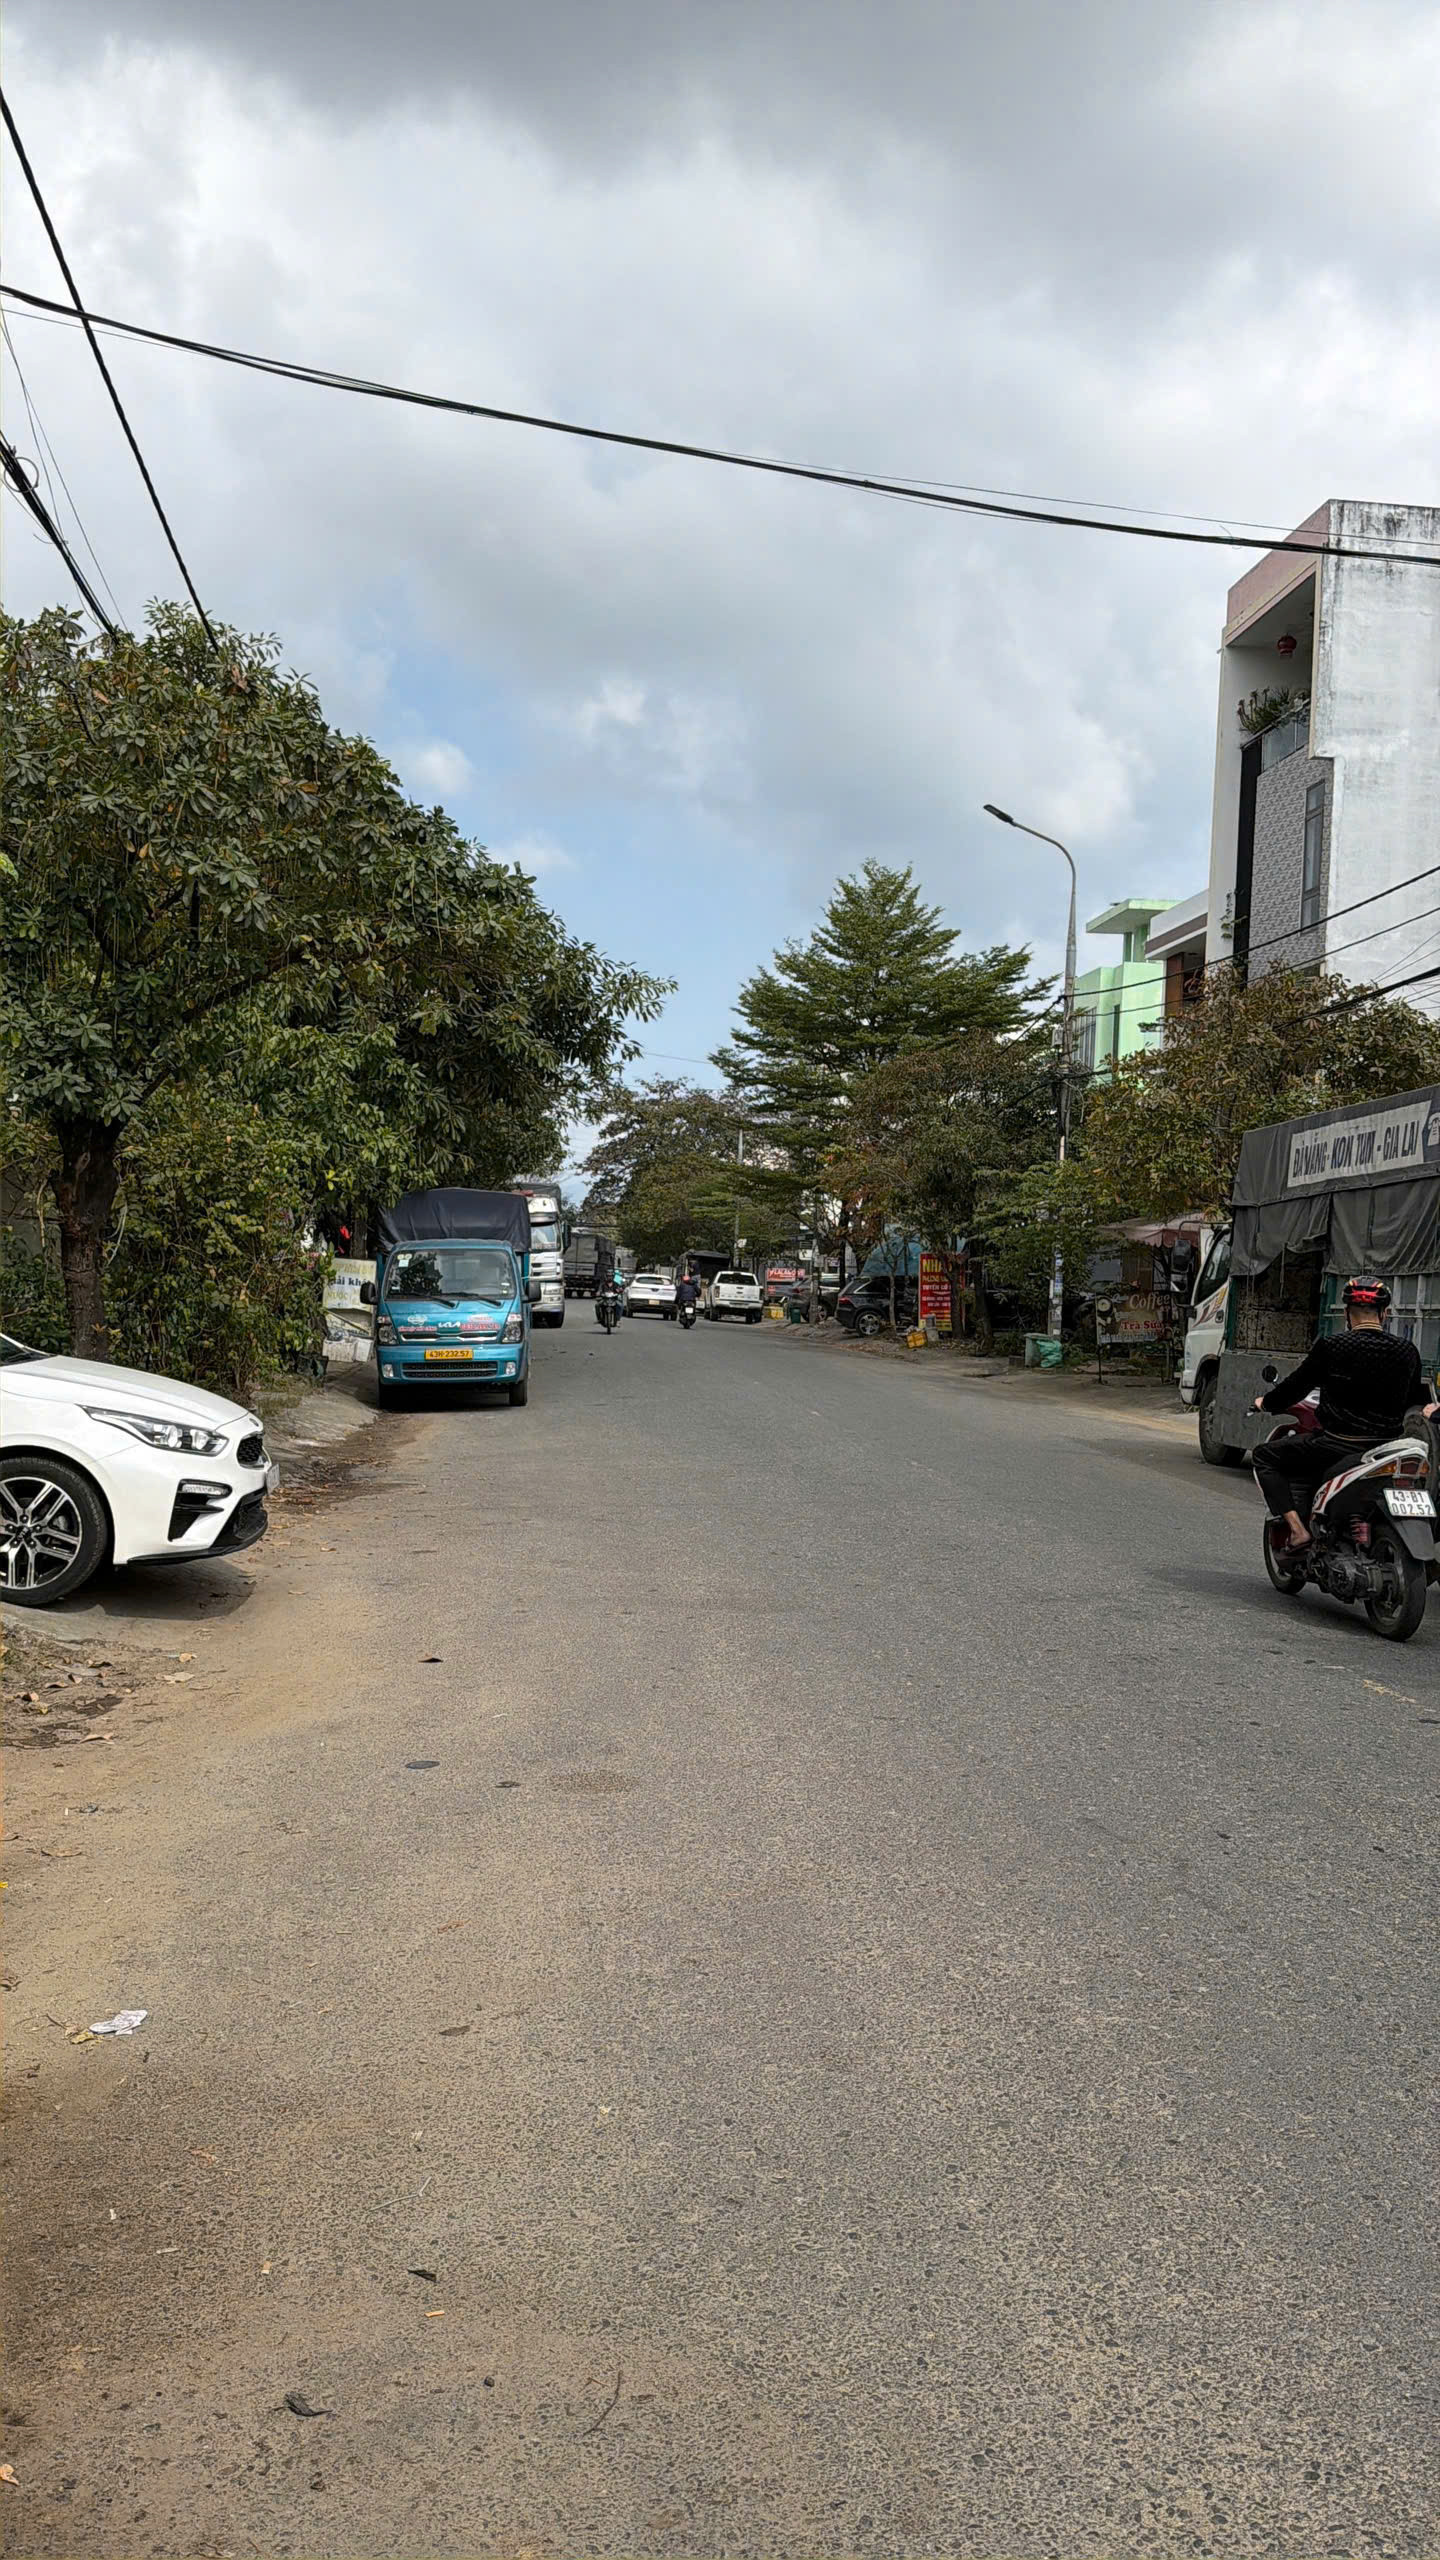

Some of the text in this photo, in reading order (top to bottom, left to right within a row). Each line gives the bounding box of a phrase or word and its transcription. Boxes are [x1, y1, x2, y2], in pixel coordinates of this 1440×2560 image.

[1383, 1125, 1399, 1161] GIA
[1401, 1120, 1420, 1157] LAI
[1129, 1292, 1170, 1310] Coffee
[1392, 1491, 1425, 1503] 43-B1
[1391, 1502, 1432, 1516] 002.52
